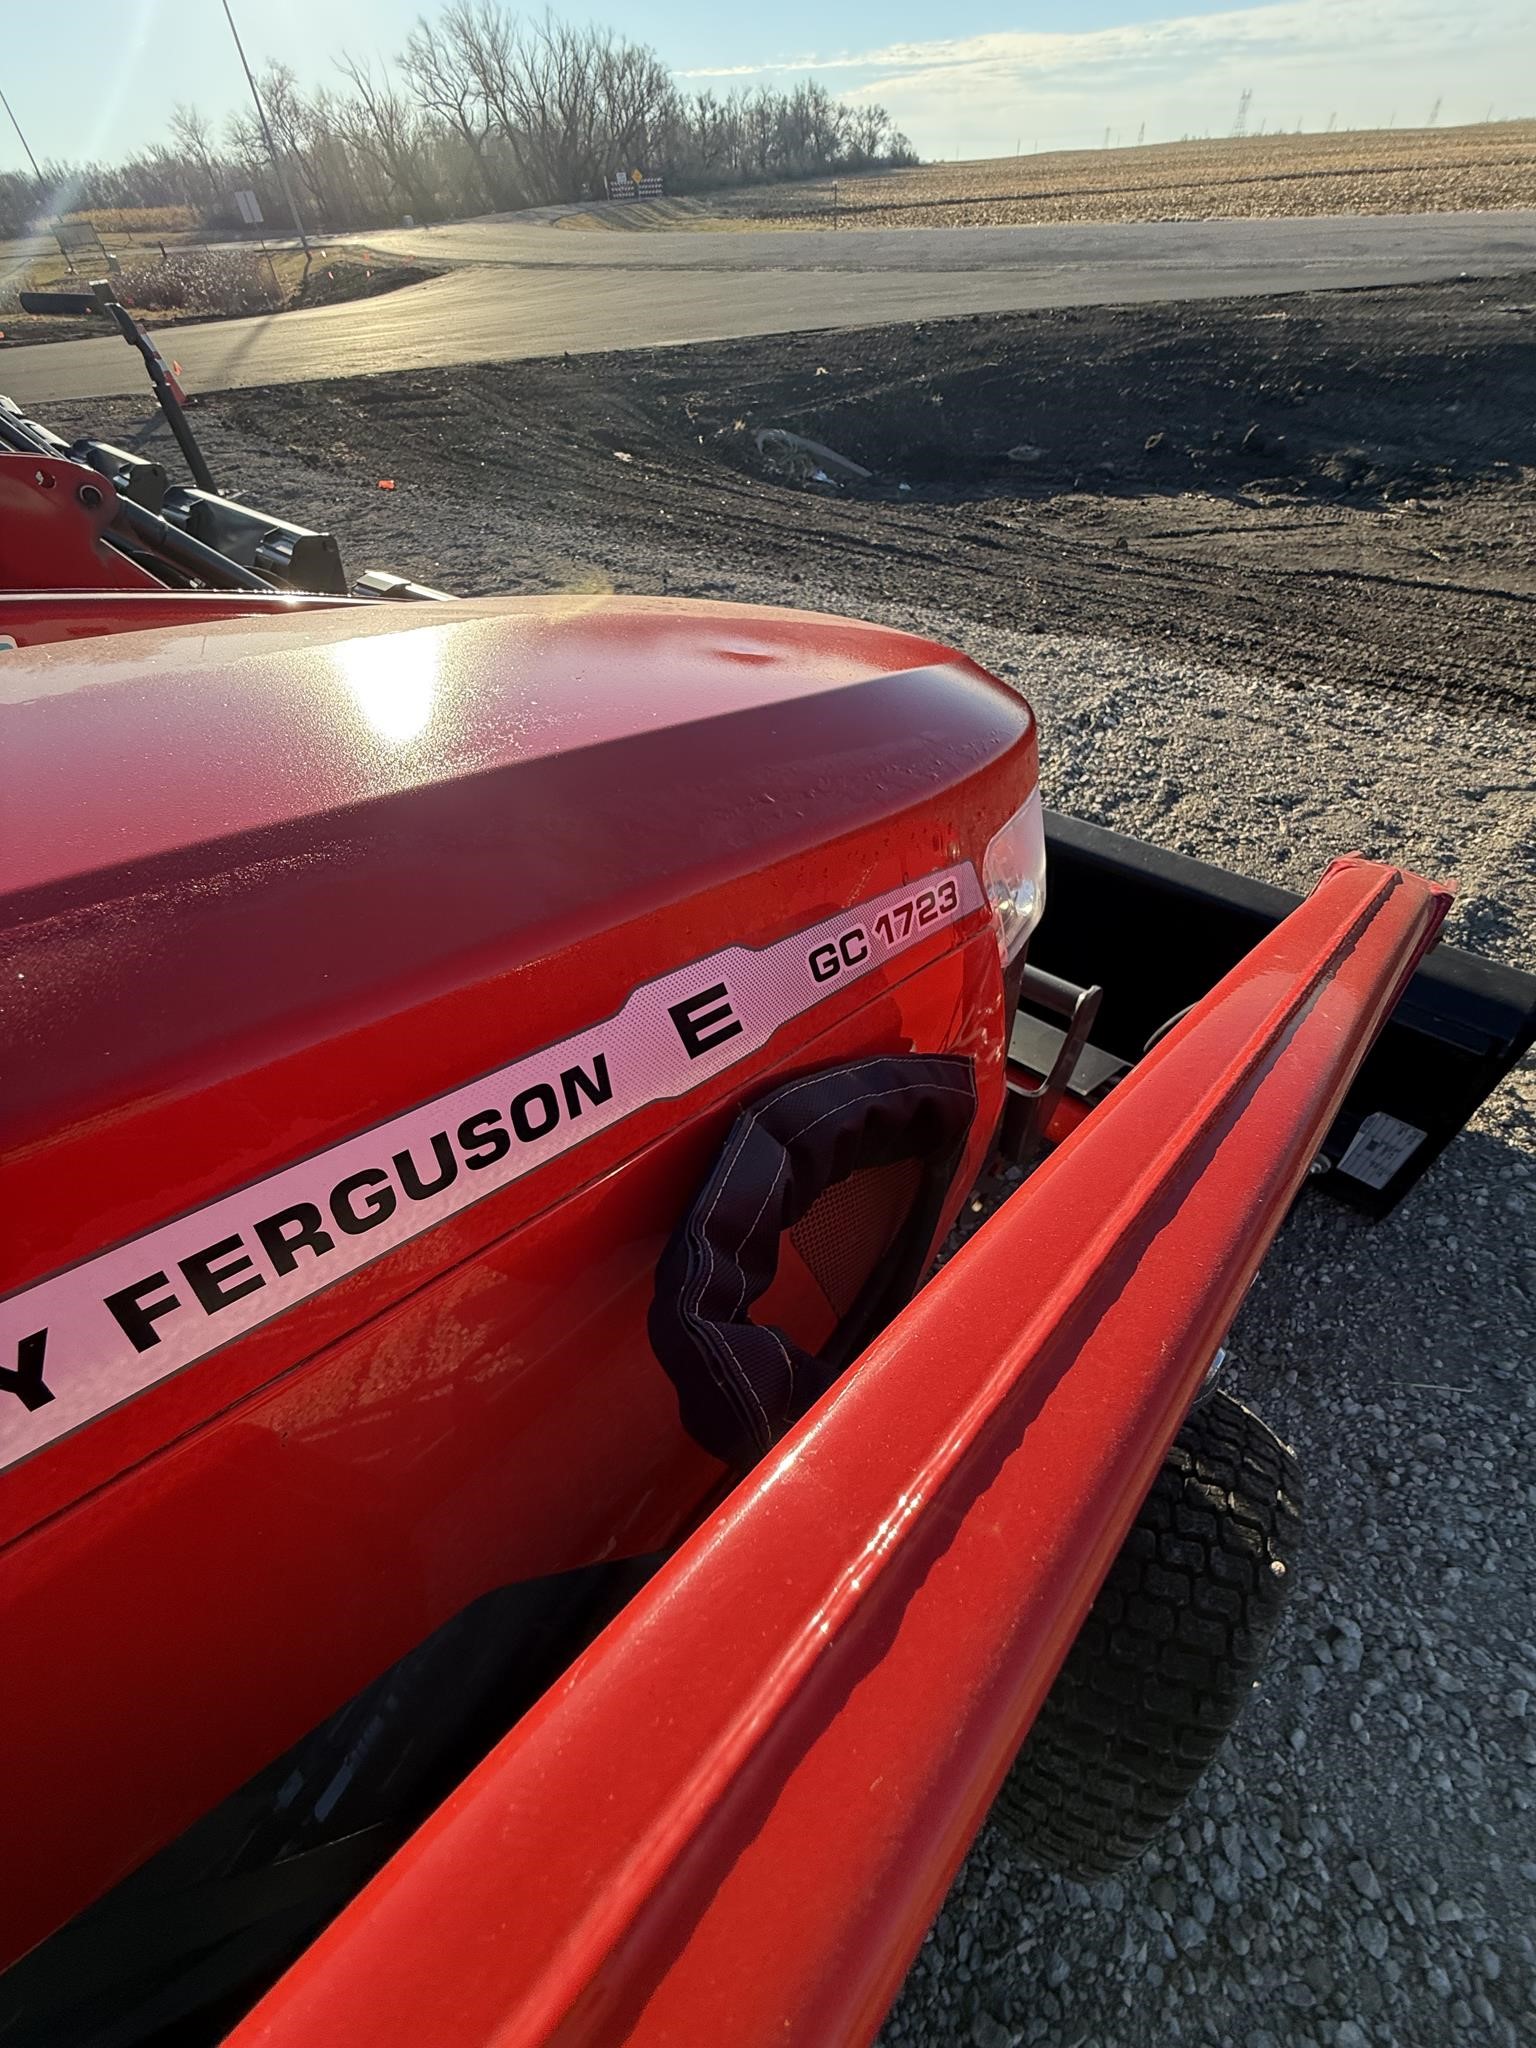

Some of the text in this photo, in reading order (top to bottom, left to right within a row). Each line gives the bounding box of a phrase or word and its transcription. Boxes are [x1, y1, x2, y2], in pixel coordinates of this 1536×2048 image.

[103, 1052, 614, 1354] FERGUSON
[667, 981, 744, 1060] E
[808, 927, 868, 983] GC
[874, 880, 958, 945] 1723
